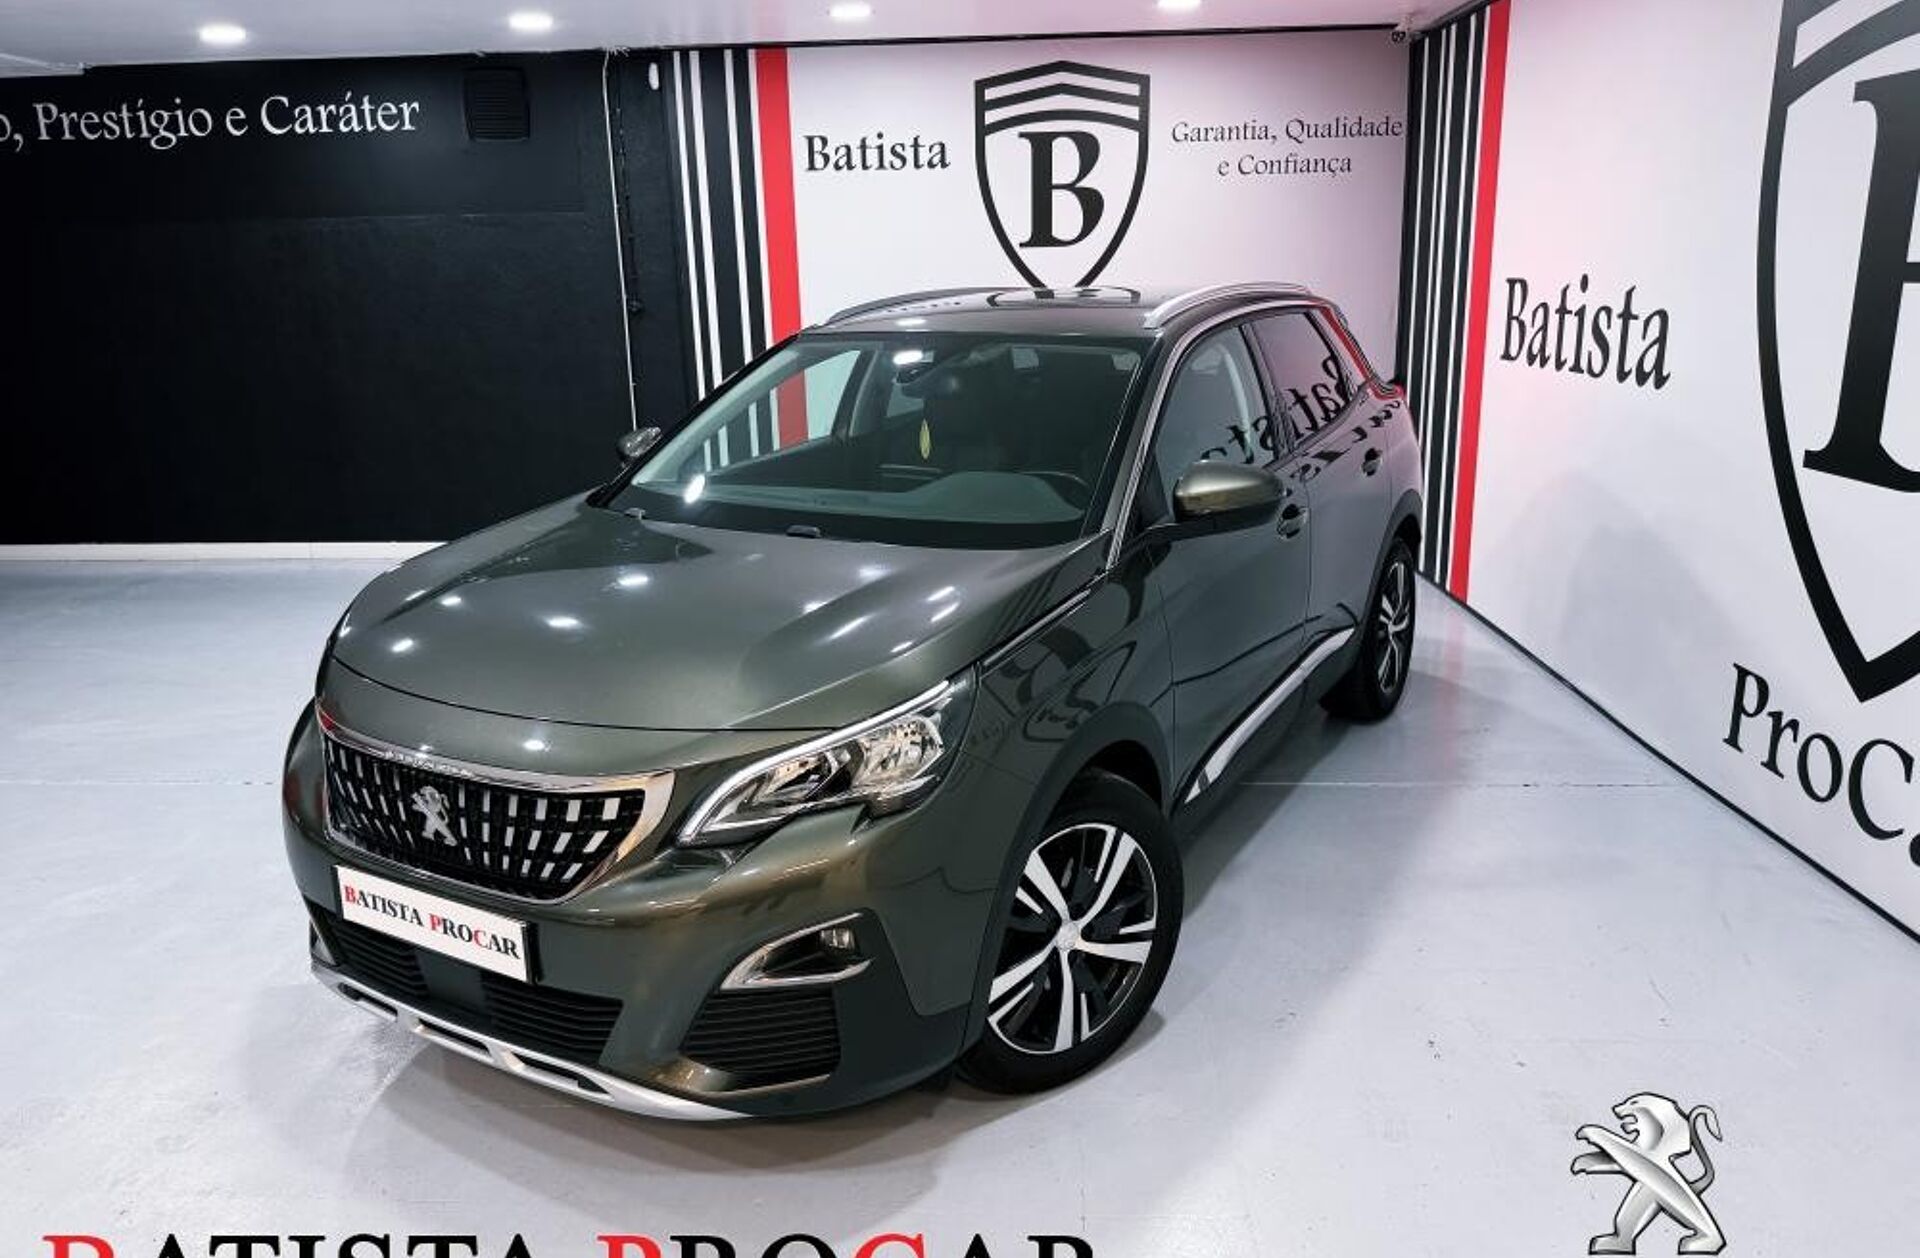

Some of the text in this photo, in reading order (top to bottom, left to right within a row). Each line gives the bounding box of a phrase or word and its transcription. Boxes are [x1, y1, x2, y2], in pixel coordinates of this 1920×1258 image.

[33, 97, 213, 150] Prestígio
[225, 107, 249, 137] e
[260, 91, 420, 135] Caráter
[804, 132, 951, 172] Batista
[1171, 116, 1404, 144] Garantia, Qualidade
[1018, 130, 1105, 248] B
[1217, 152, 1352, 178] e Confiança
[1500, 273, 1671, 390] Batista
[1723, 662, 1920, 867] ProC
[344, 886, 521, 959] BATISTA PROCAR
